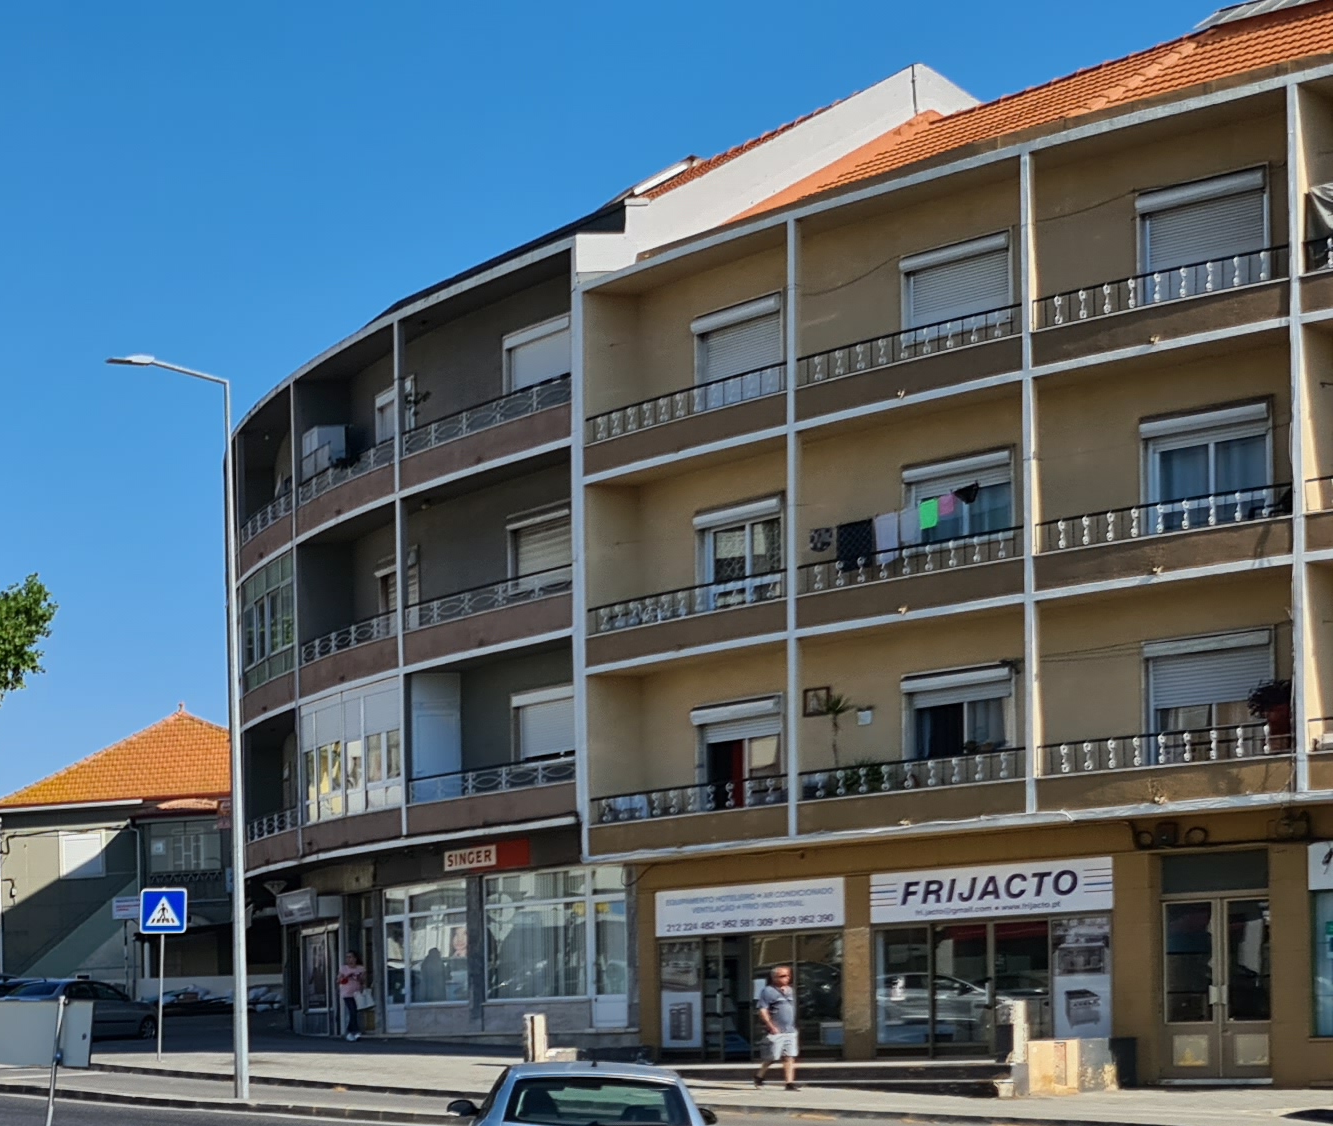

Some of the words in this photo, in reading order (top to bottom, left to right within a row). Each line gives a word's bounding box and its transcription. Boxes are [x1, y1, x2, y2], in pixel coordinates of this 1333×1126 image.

[447, 850, 492, 867] SINGER
[776, 887, 833, 898] CONDICIONADO
[900, 870, 1078, 905] FRIJACTO
[761, 900, 804, 909] INDUSTRIAL
[1001, 900, 1061, 912] www.frijacto.pt
[666, 924, 681, 932] 212
[683, 922, 697, 931] 224
[700, 921, 715, 930] 482
[740, 919, 755, 927] 581
